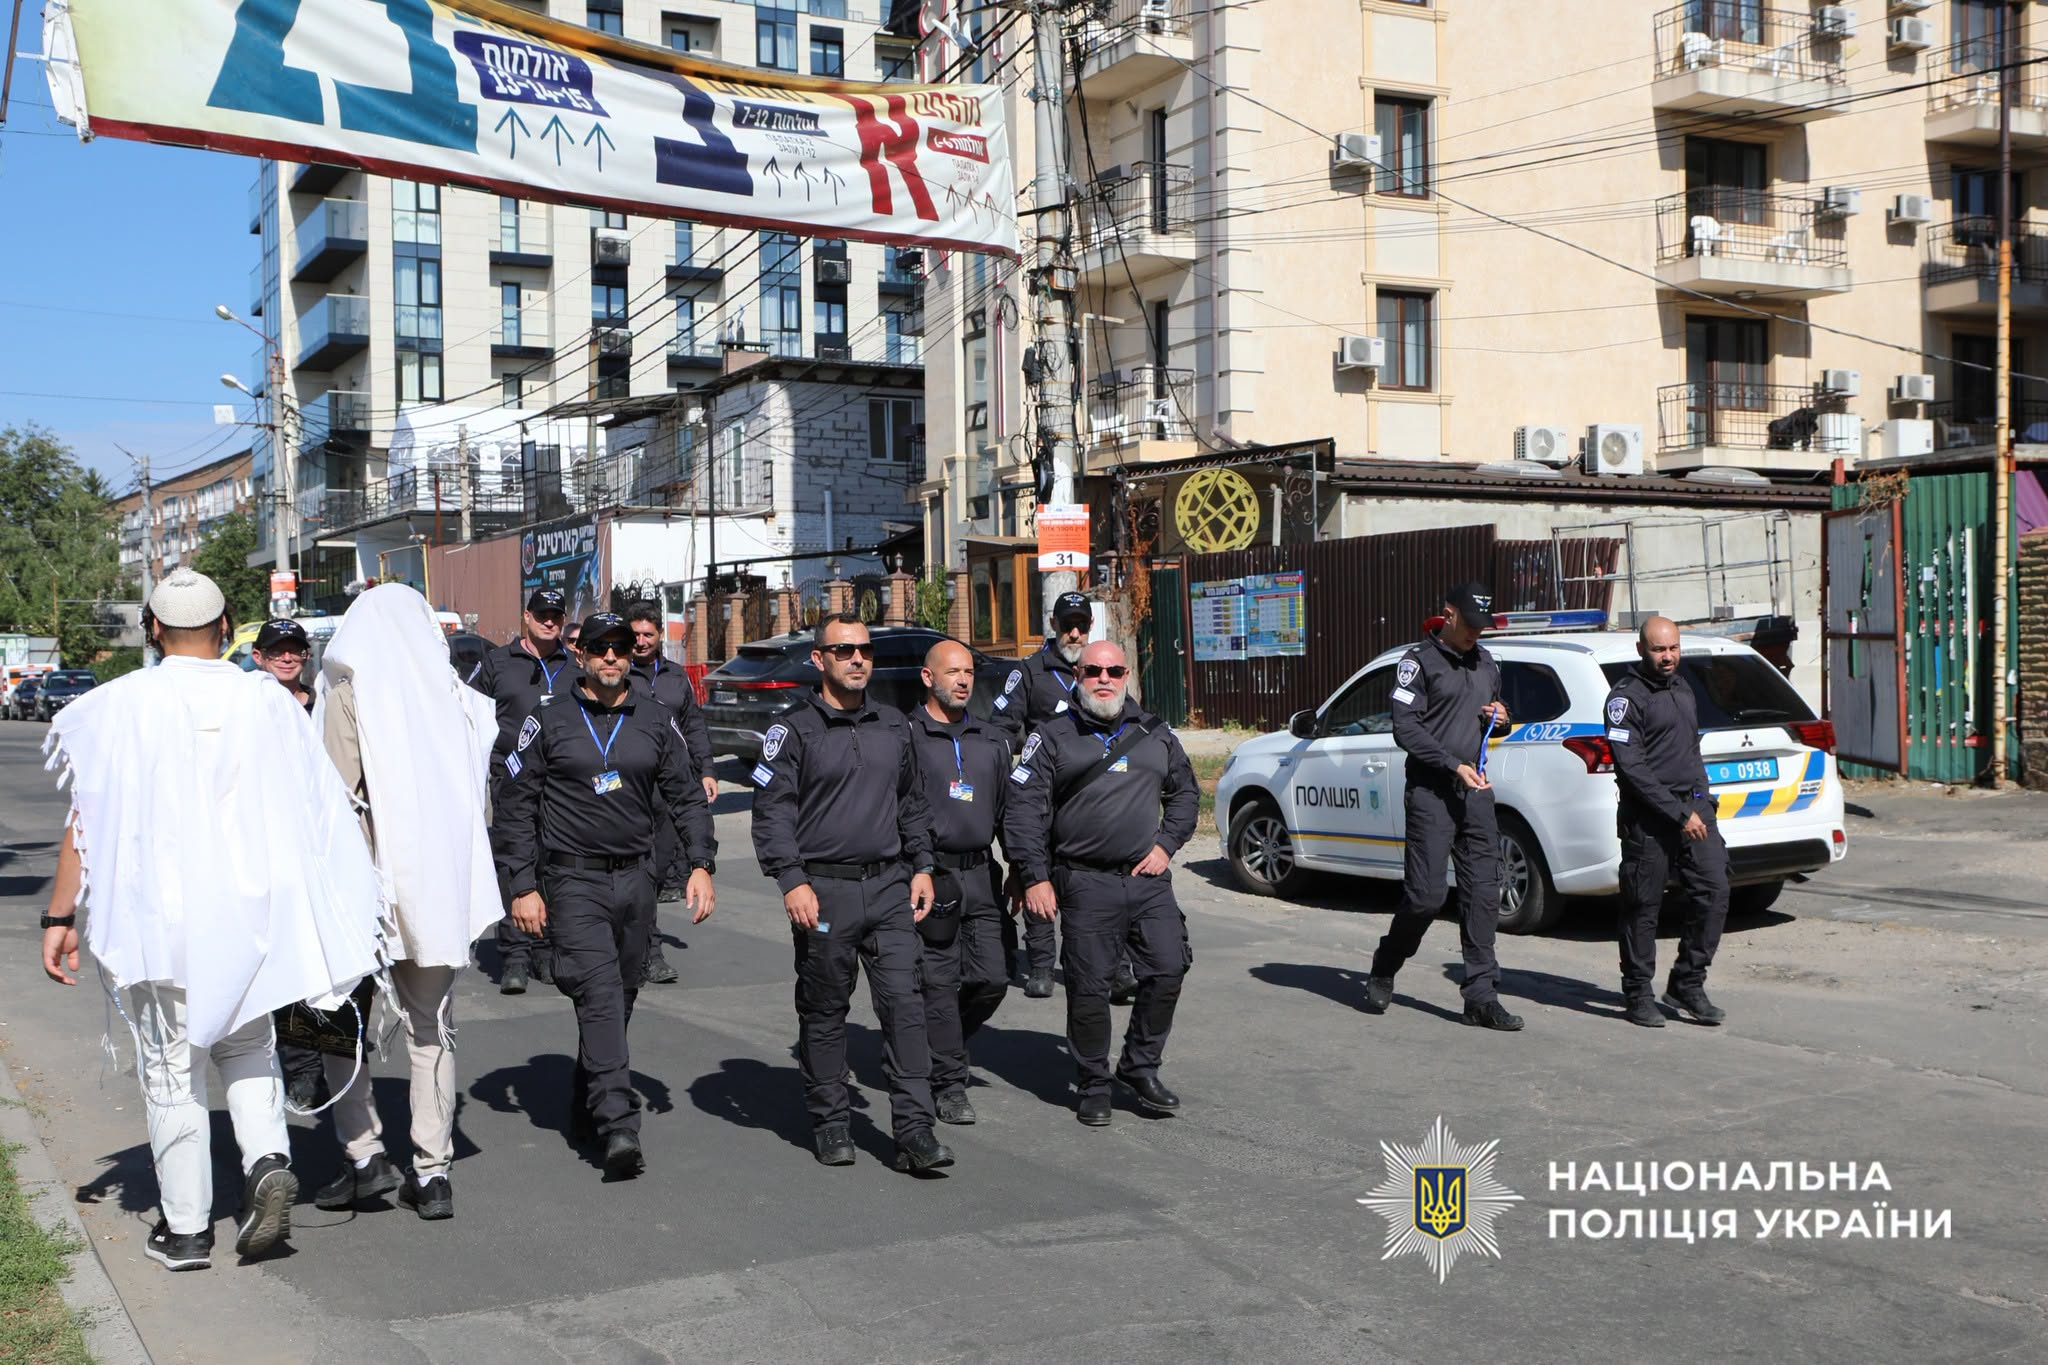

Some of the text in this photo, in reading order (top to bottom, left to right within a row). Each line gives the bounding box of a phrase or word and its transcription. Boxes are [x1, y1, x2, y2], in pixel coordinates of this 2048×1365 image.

[482, 43, 570, 83] אולמות
[488, 67, 593, 111] 13-14-15
[741, 105, 769, 128] 7-12
[536, 527, 579, 558] קארטינג
[1056, 553, 1073, 566] 31
[1540, 723, 1571, 740] 102
[1737, 761, 1771, 779] 0938
[1295, 785, 1360, 809] ПОЛІЦІЯ
